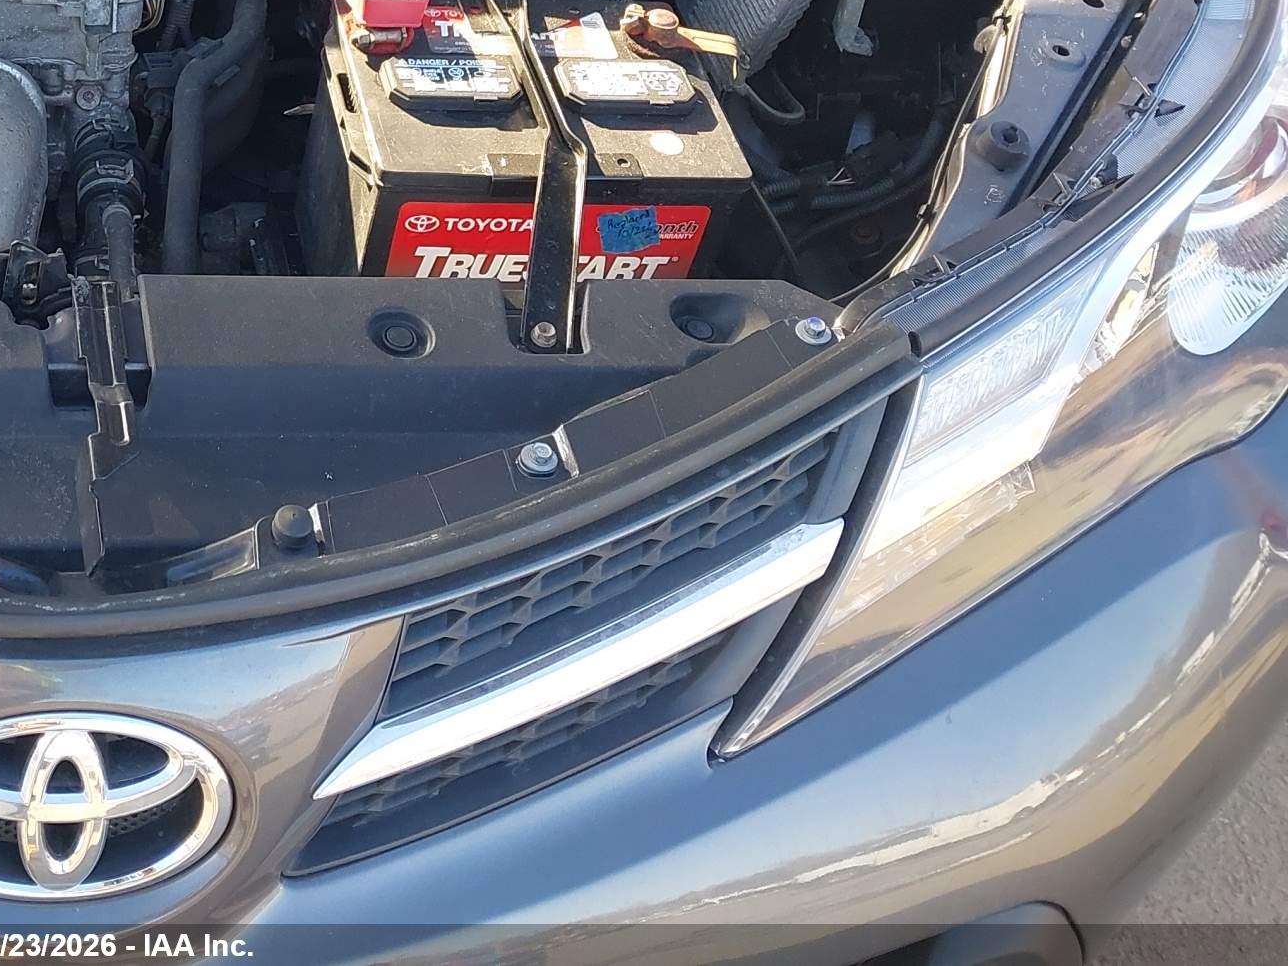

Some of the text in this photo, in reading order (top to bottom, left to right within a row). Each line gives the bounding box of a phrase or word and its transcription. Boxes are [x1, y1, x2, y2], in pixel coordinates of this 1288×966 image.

[408, 58, 449, 66] DANGER
[444, 217, 535, 233] TOYOTA
[658, 233, 694, 241] ARRANTY
